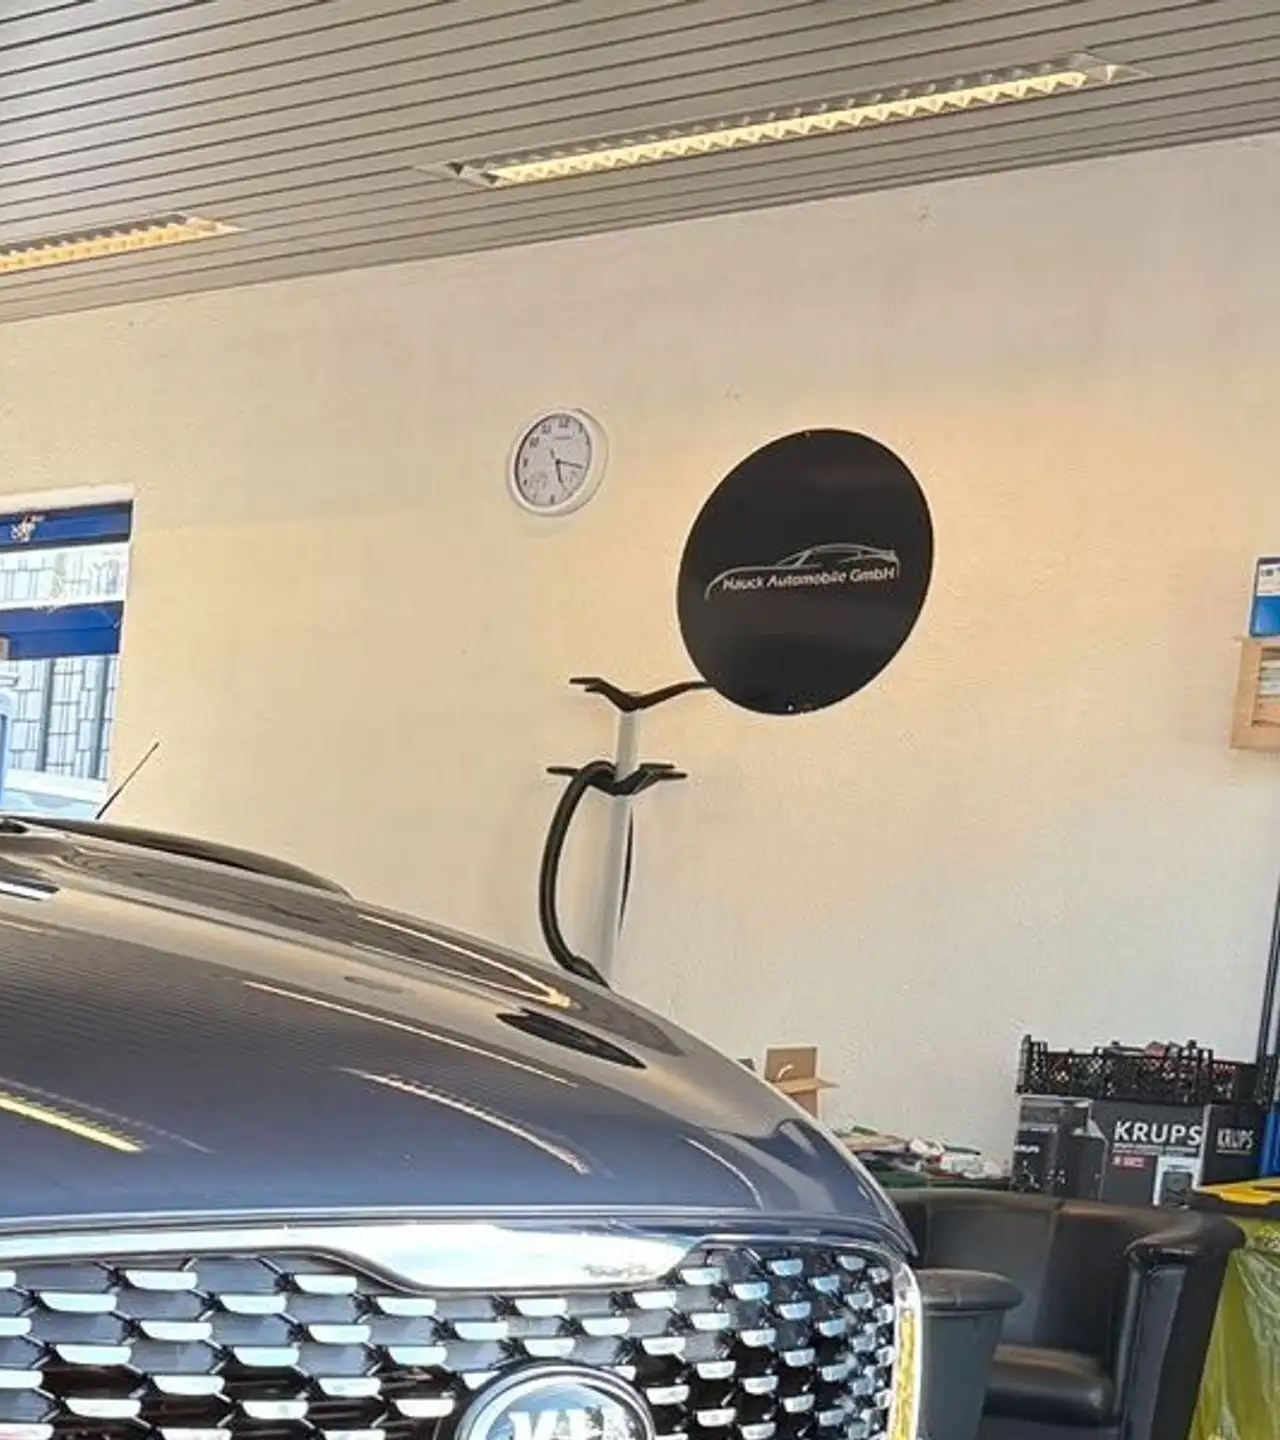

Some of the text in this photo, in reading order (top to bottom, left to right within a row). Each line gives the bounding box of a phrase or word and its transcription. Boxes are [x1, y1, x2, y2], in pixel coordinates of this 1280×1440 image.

[722, 567, 896, 591] Hauck Automobile GmbH
[1113, 1120, 1204, 1147] KRUPS
